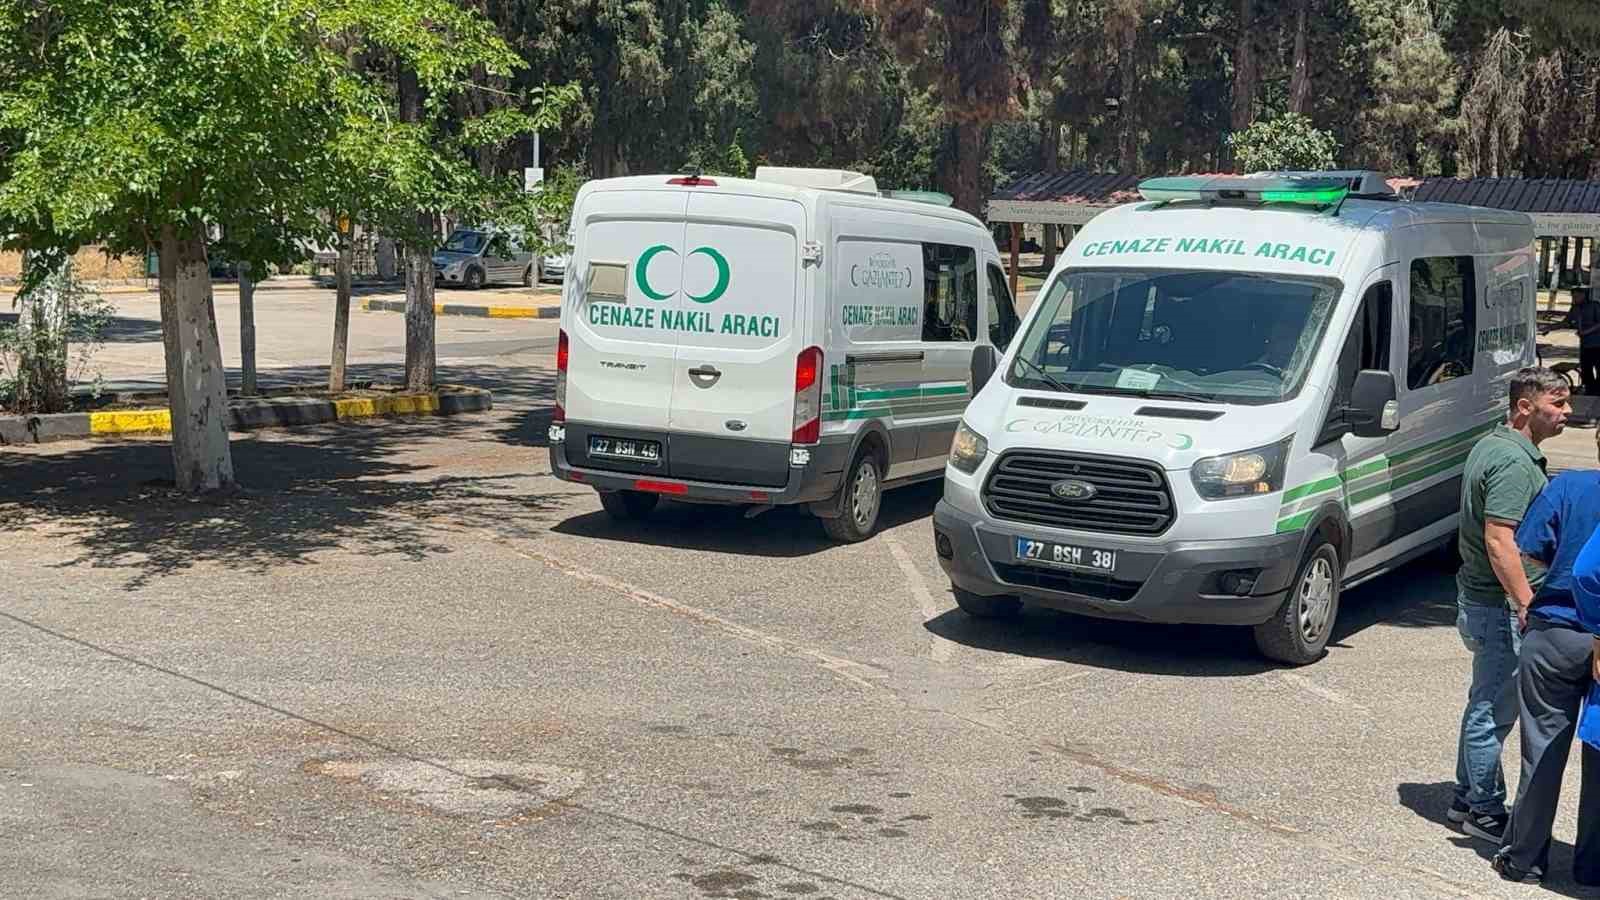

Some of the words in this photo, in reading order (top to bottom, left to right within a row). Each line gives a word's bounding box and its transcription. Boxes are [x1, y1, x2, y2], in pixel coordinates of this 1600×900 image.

[1082, 237, 1172, 258] CENAZE
[1254, 241, 1336, 267] ARACI
[589, 303, 655, 329] CENAZE
[720, 313, 780, 338] ARACI
[842, 304, 873, 326] CENAZE
[596, 439, 609, 452] 27
[615, 441, 636, 456] BSH
[1026, 541, 1044, 559] 27
[1053, 544, 1082, 564] BSH
[1092, 550, 1112, 568] 38
